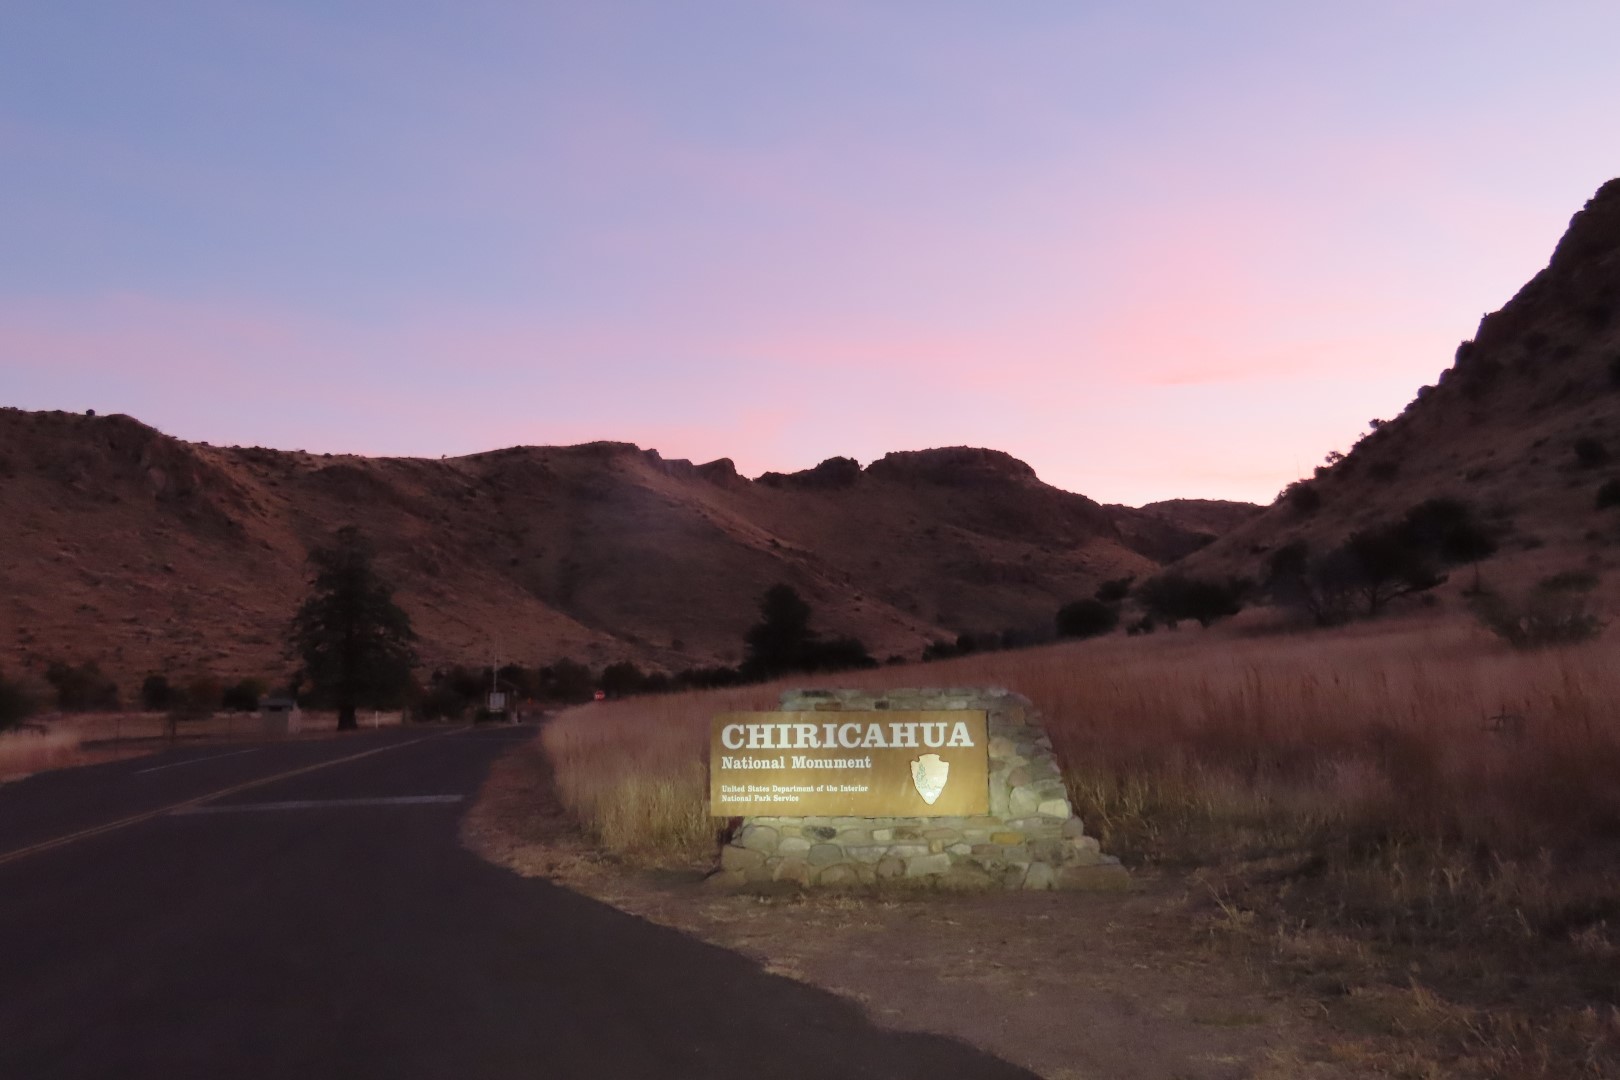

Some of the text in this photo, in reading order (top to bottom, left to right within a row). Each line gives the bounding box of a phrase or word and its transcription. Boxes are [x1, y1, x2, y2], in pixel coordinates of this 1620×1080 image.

[721, 722, 974, 749] CHIRICAHUA
[721, 756, 872, 769] National Monument
[722, 785, 745, 793] United
[747, 785, 770, 793] States
[772, 785, 814, 794] Department
[721, 794, 799, 802] National Park Service
